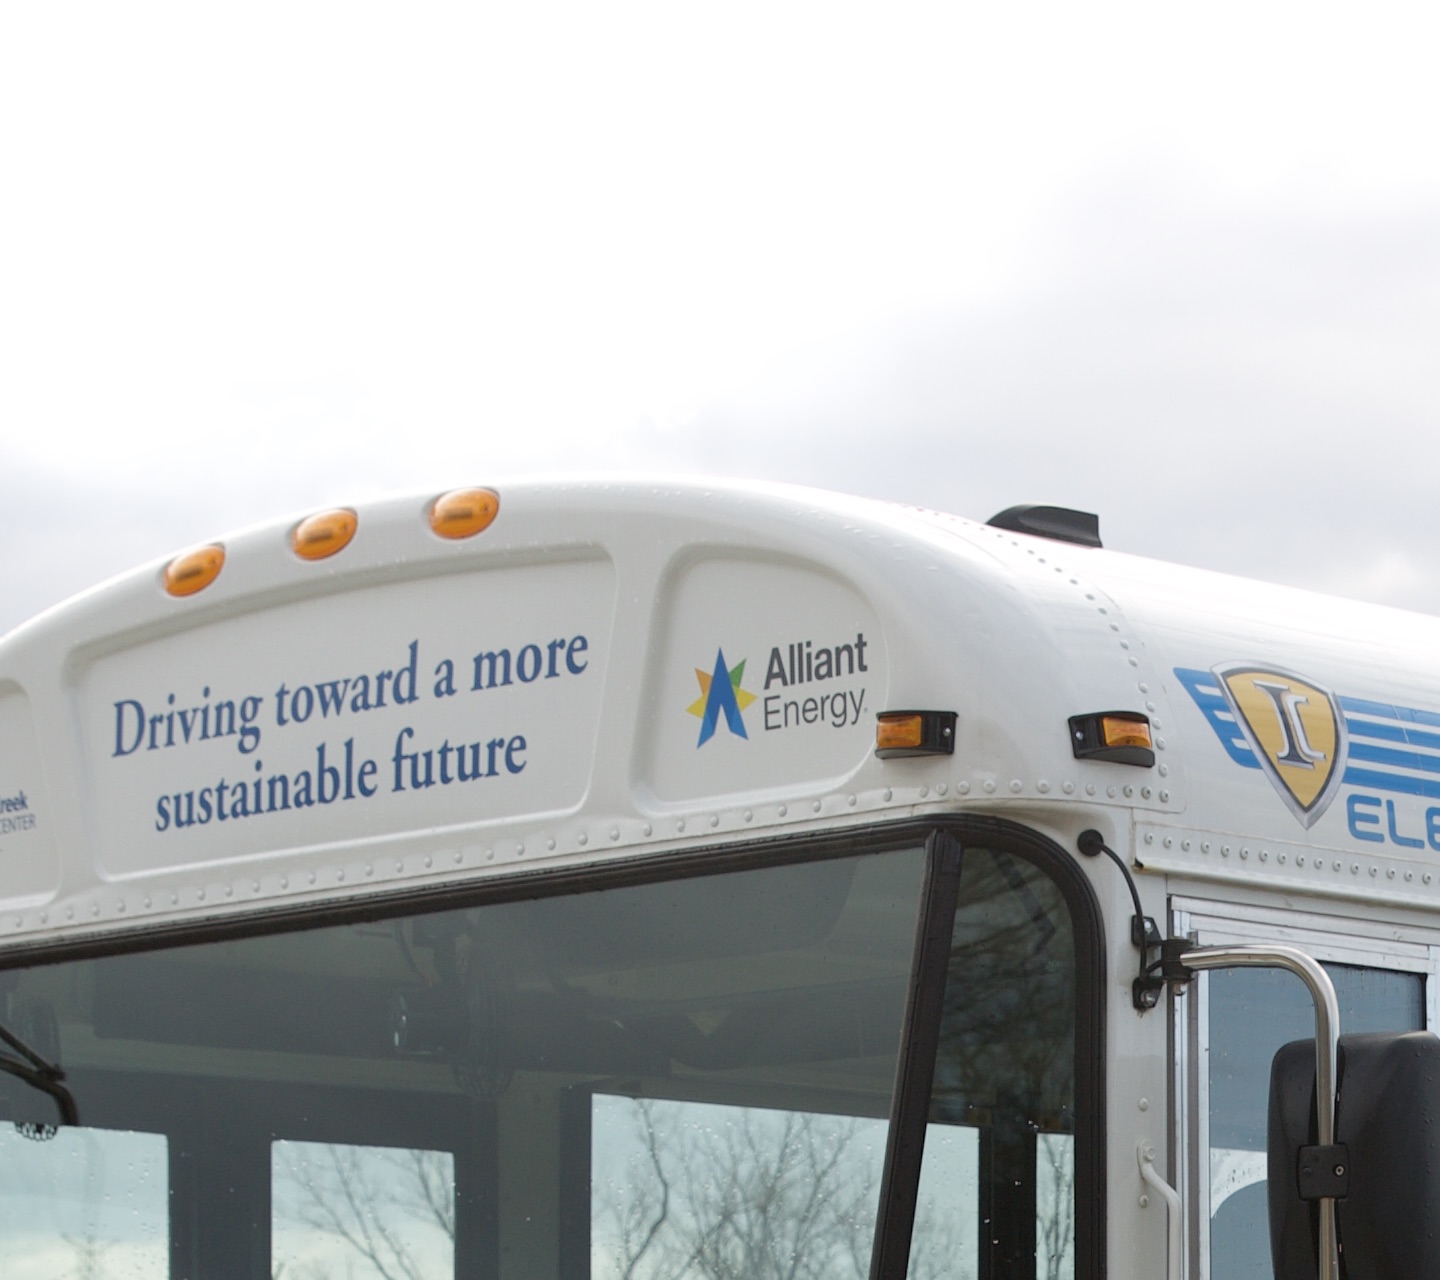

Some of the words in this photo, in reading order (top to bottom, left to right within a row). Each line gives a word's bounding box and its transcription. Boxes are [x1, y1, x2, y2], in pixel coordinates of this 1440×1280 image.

[112, 685, 263, 757] Driving
[275, 639, 419, 727] toward
[433, 656, 457, 698] a
[470, 633, 590, 692] more
[764, 633, 868, 690] Alliant
[764, 688, 866, 731] Energy
[154, 737, 379, 832] sustainable
[391, 726, 528, 793] future
